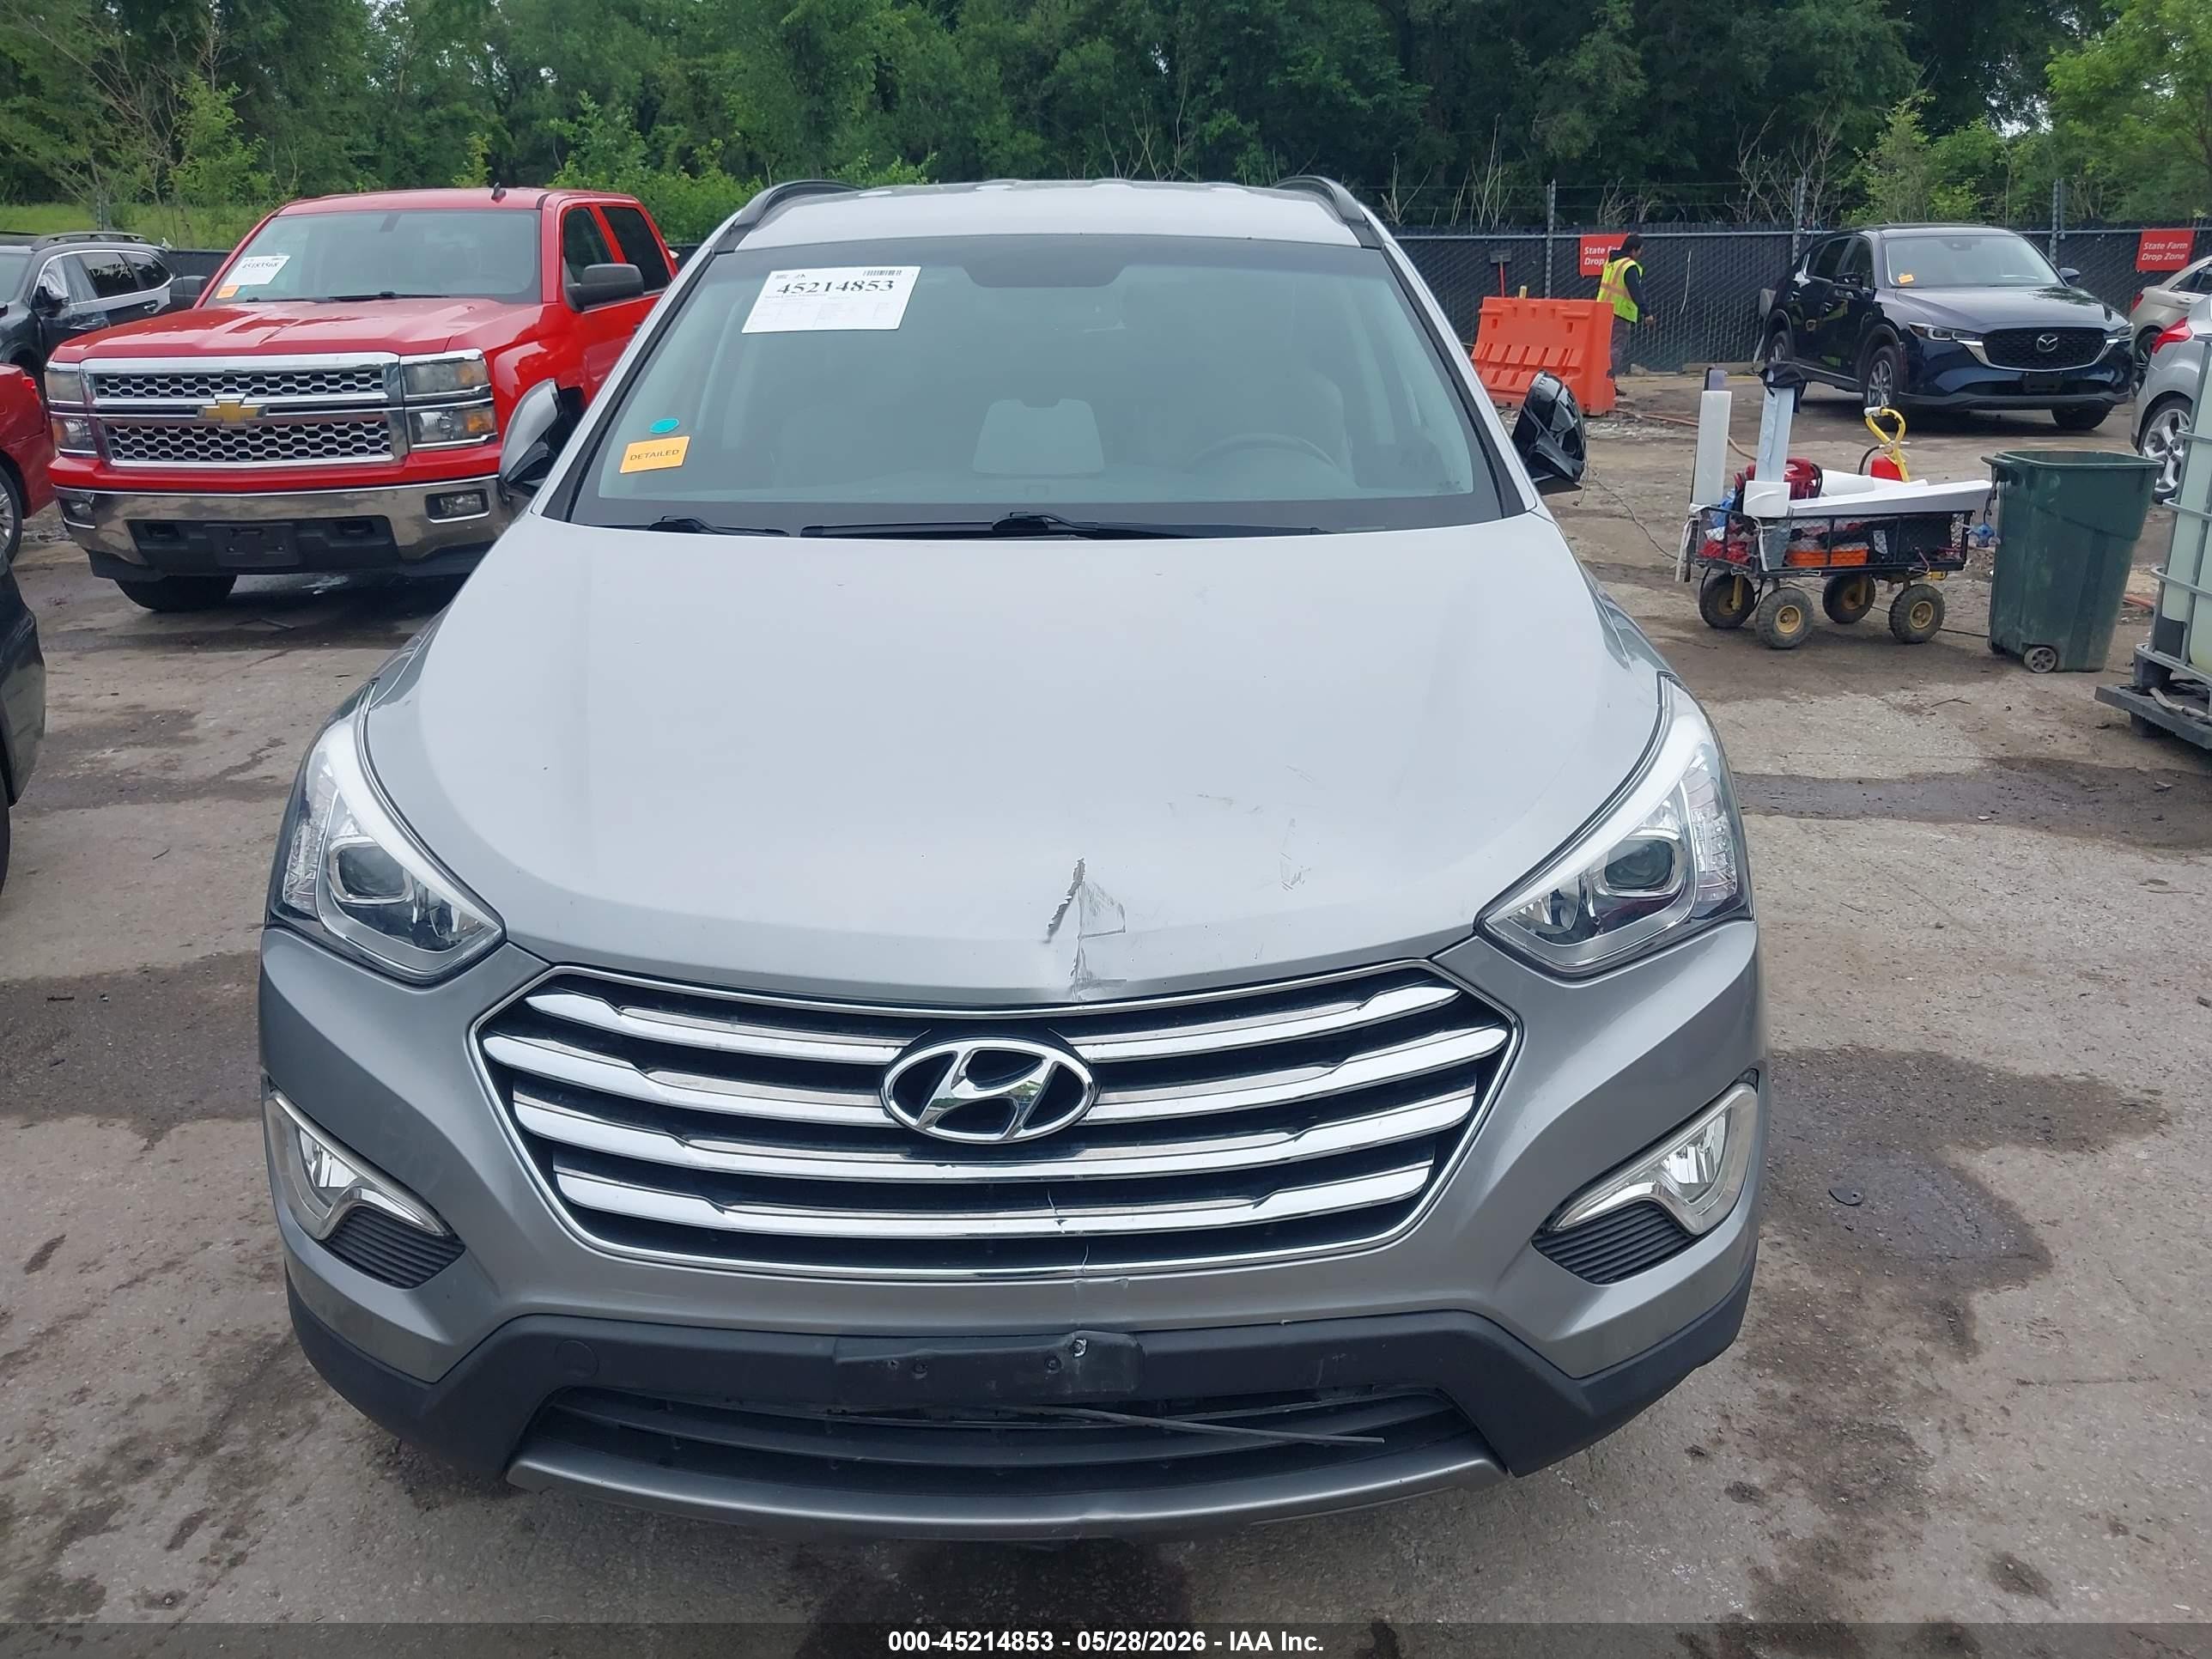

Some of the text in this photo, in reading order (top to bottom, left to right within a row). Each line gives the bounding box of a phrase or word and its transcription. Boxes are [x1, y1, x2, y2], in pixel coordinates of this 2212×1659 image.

[1583, 246, 1605, 255] State
[2166, 241, 2188, 250] Farm
[1584, 257, 1604, 267] Drop
[2142, 252, 2162, 262] Drop
[776, 280, 894, 294] 45214853
[629, 449, 680, 460] DETAILED
